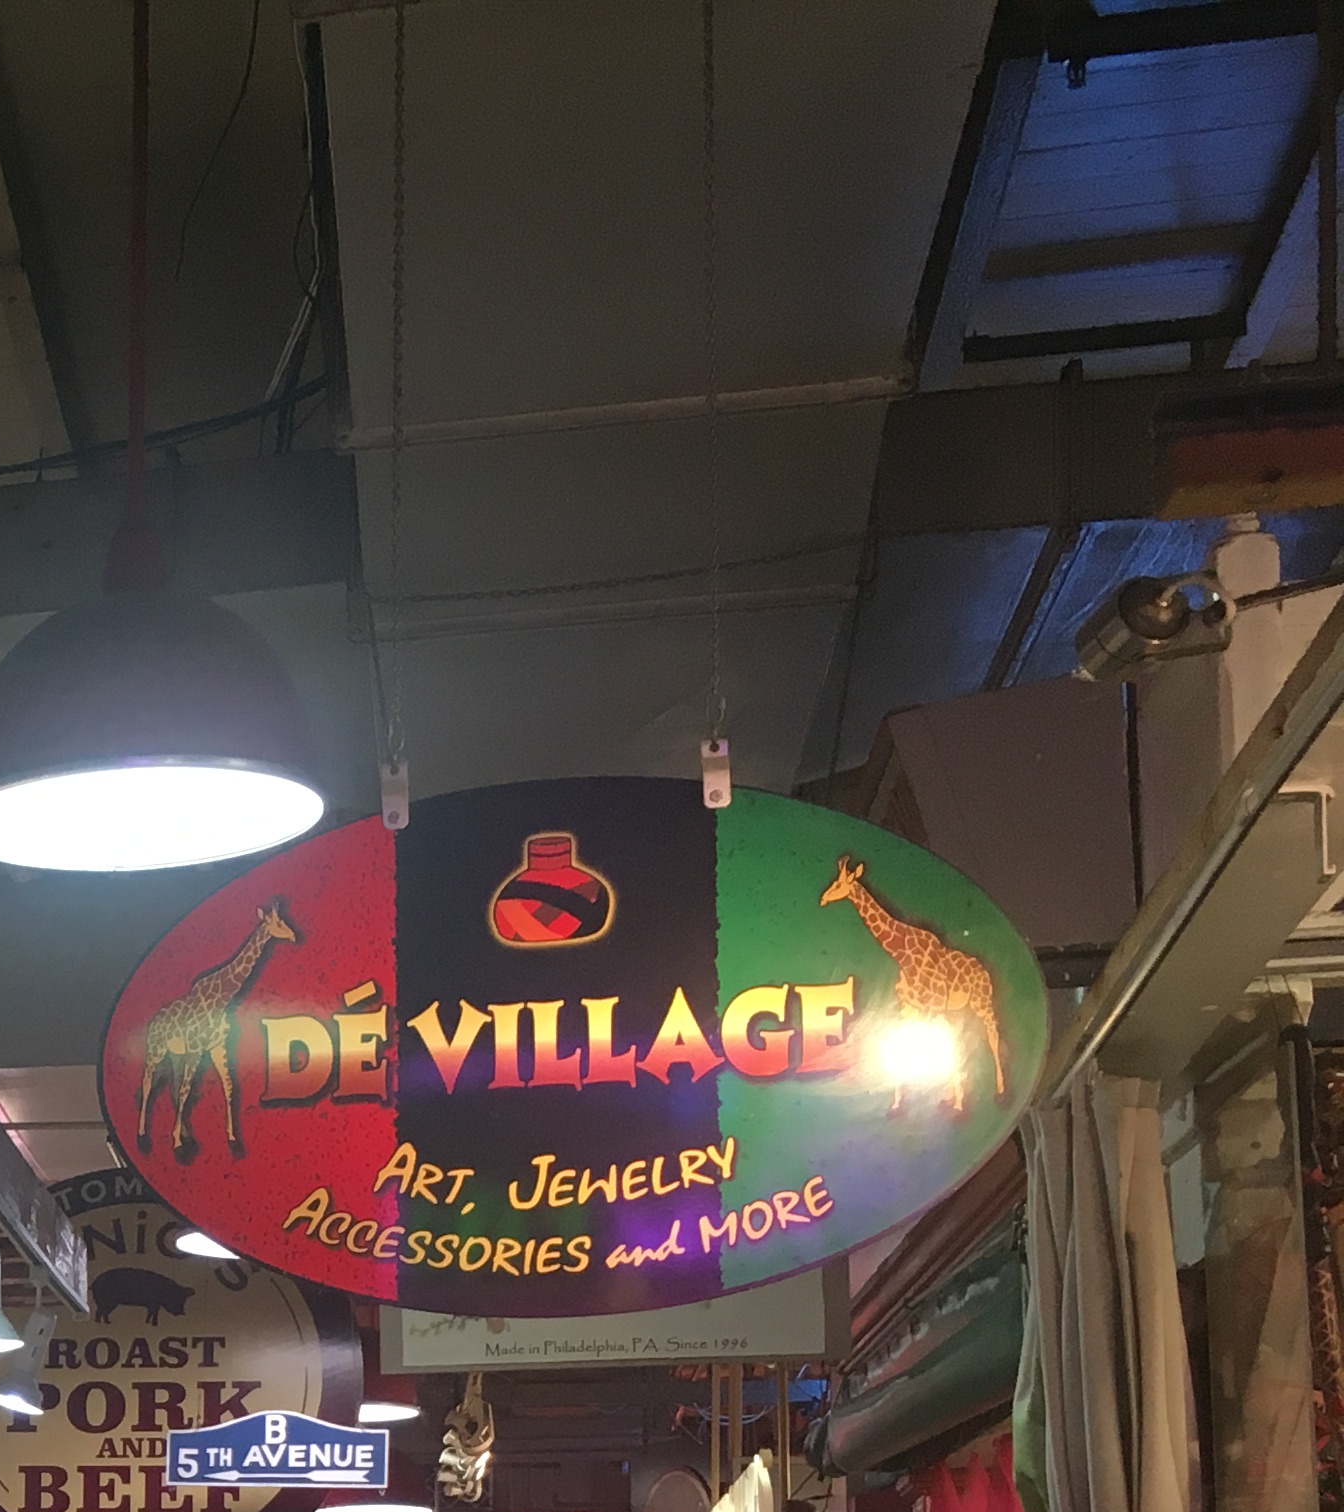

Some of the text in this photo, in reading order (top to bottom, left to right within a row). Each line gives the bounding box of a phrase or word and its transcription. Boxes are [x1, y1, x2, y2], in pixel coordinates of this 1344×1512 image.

[261, 976, 854, 1107] DÉ VILLAGE
[509, 1137, 737, 1210] JEWELRY
[283, 1174, 834, 1275] ACCESSORIES and MORE
[45, 1336, 226, 1370] ROAST
[484, 1341, 524, 1357] Made
[528, 1342, 540, 1355] in
[544, 1339, 629, 1359] Philadelphia,
[666, 1336, 708, 1351] Since
[713, 1336, 748, 1350] 1996
[6, 1380, 262, 1433] PORK
[264, 1415, 287, 1444] B
[95, 1437, 166, 1459] AND
[242, 1443, 374, 1469] AVENUE
